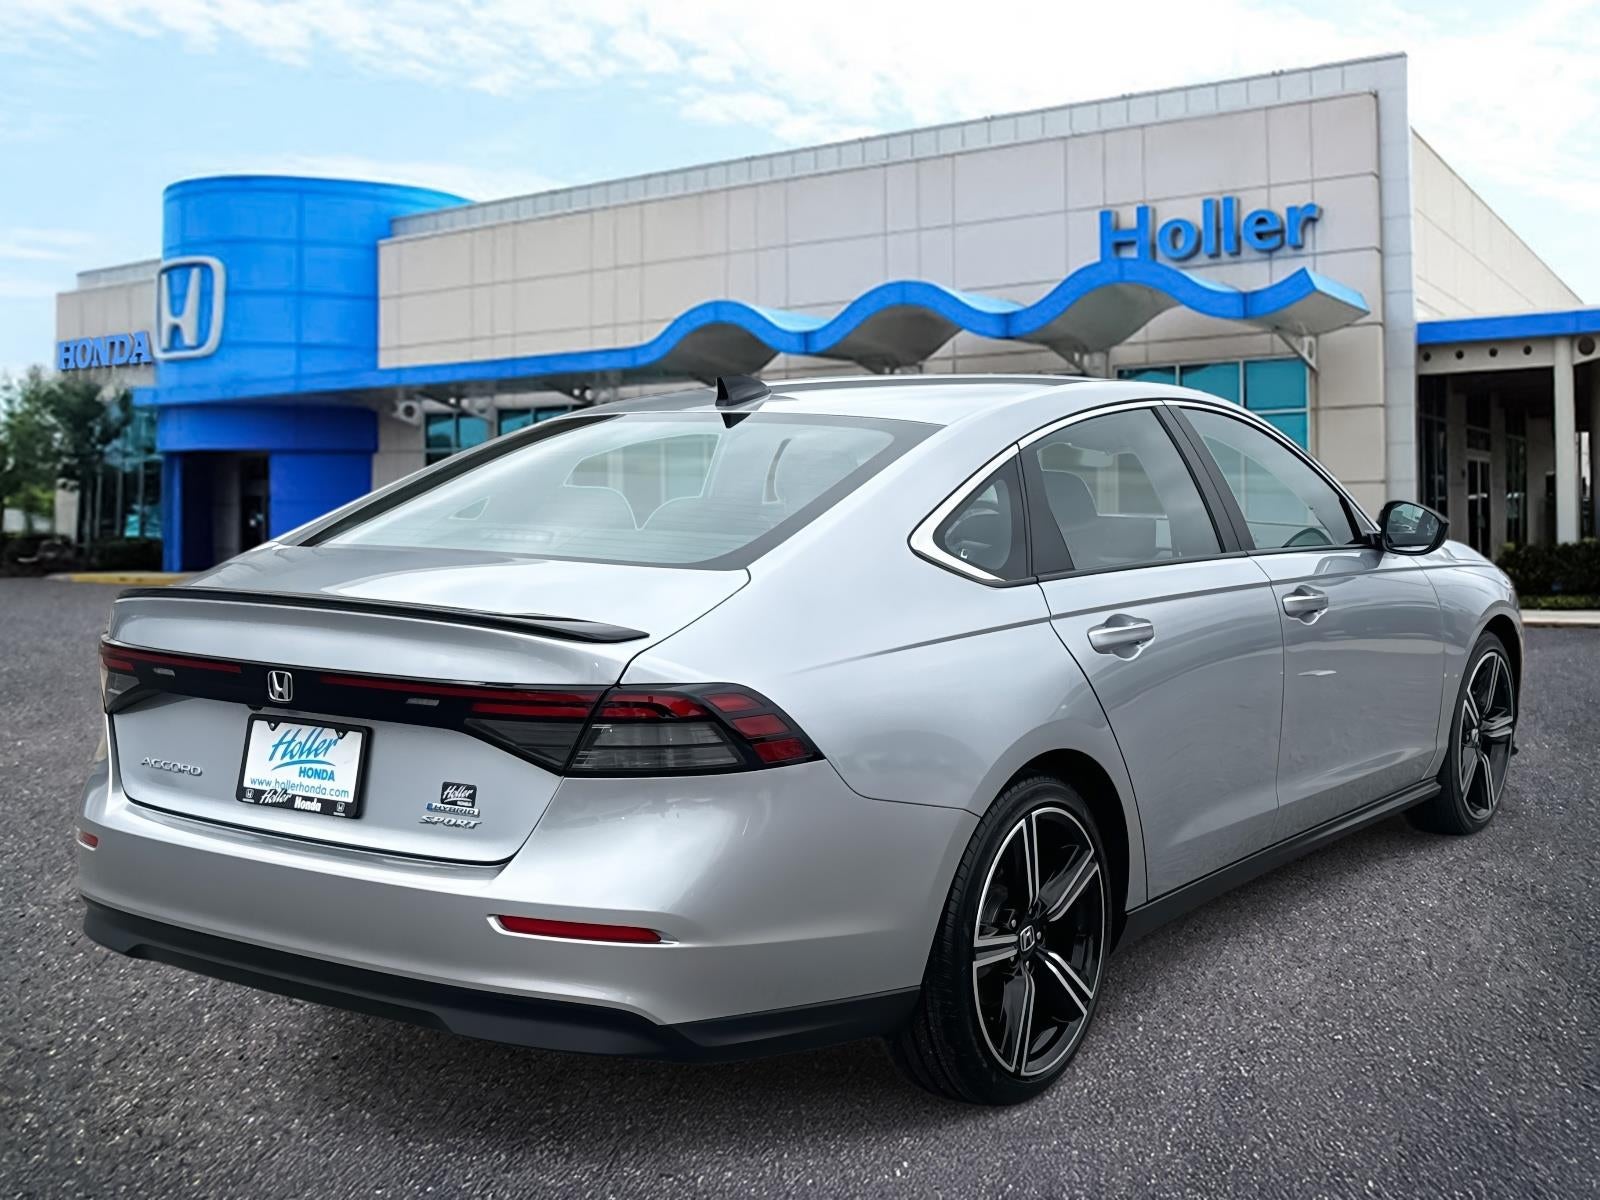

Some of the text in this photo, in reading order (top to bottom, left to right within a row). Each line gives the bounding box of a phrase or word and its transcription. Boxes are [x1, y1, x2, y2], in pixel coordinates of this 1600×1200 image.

[1099, 196, 1321, 261] Holler
[57, 330, 152, 370] HONDA
[268, 727, 339, 762] Holler
[141, 757, 202, 776] ACCORD
[298, 766, 336, 782] HONDA
[250, 777, 350, 799] www.hollerhonda.com
[442, 785, 474, 799] Holler
[260, 788, 322, 812] Holler Honda
[433, 804, 477, 815] HYBRID
[420, 815, 482, 829] SPORT
